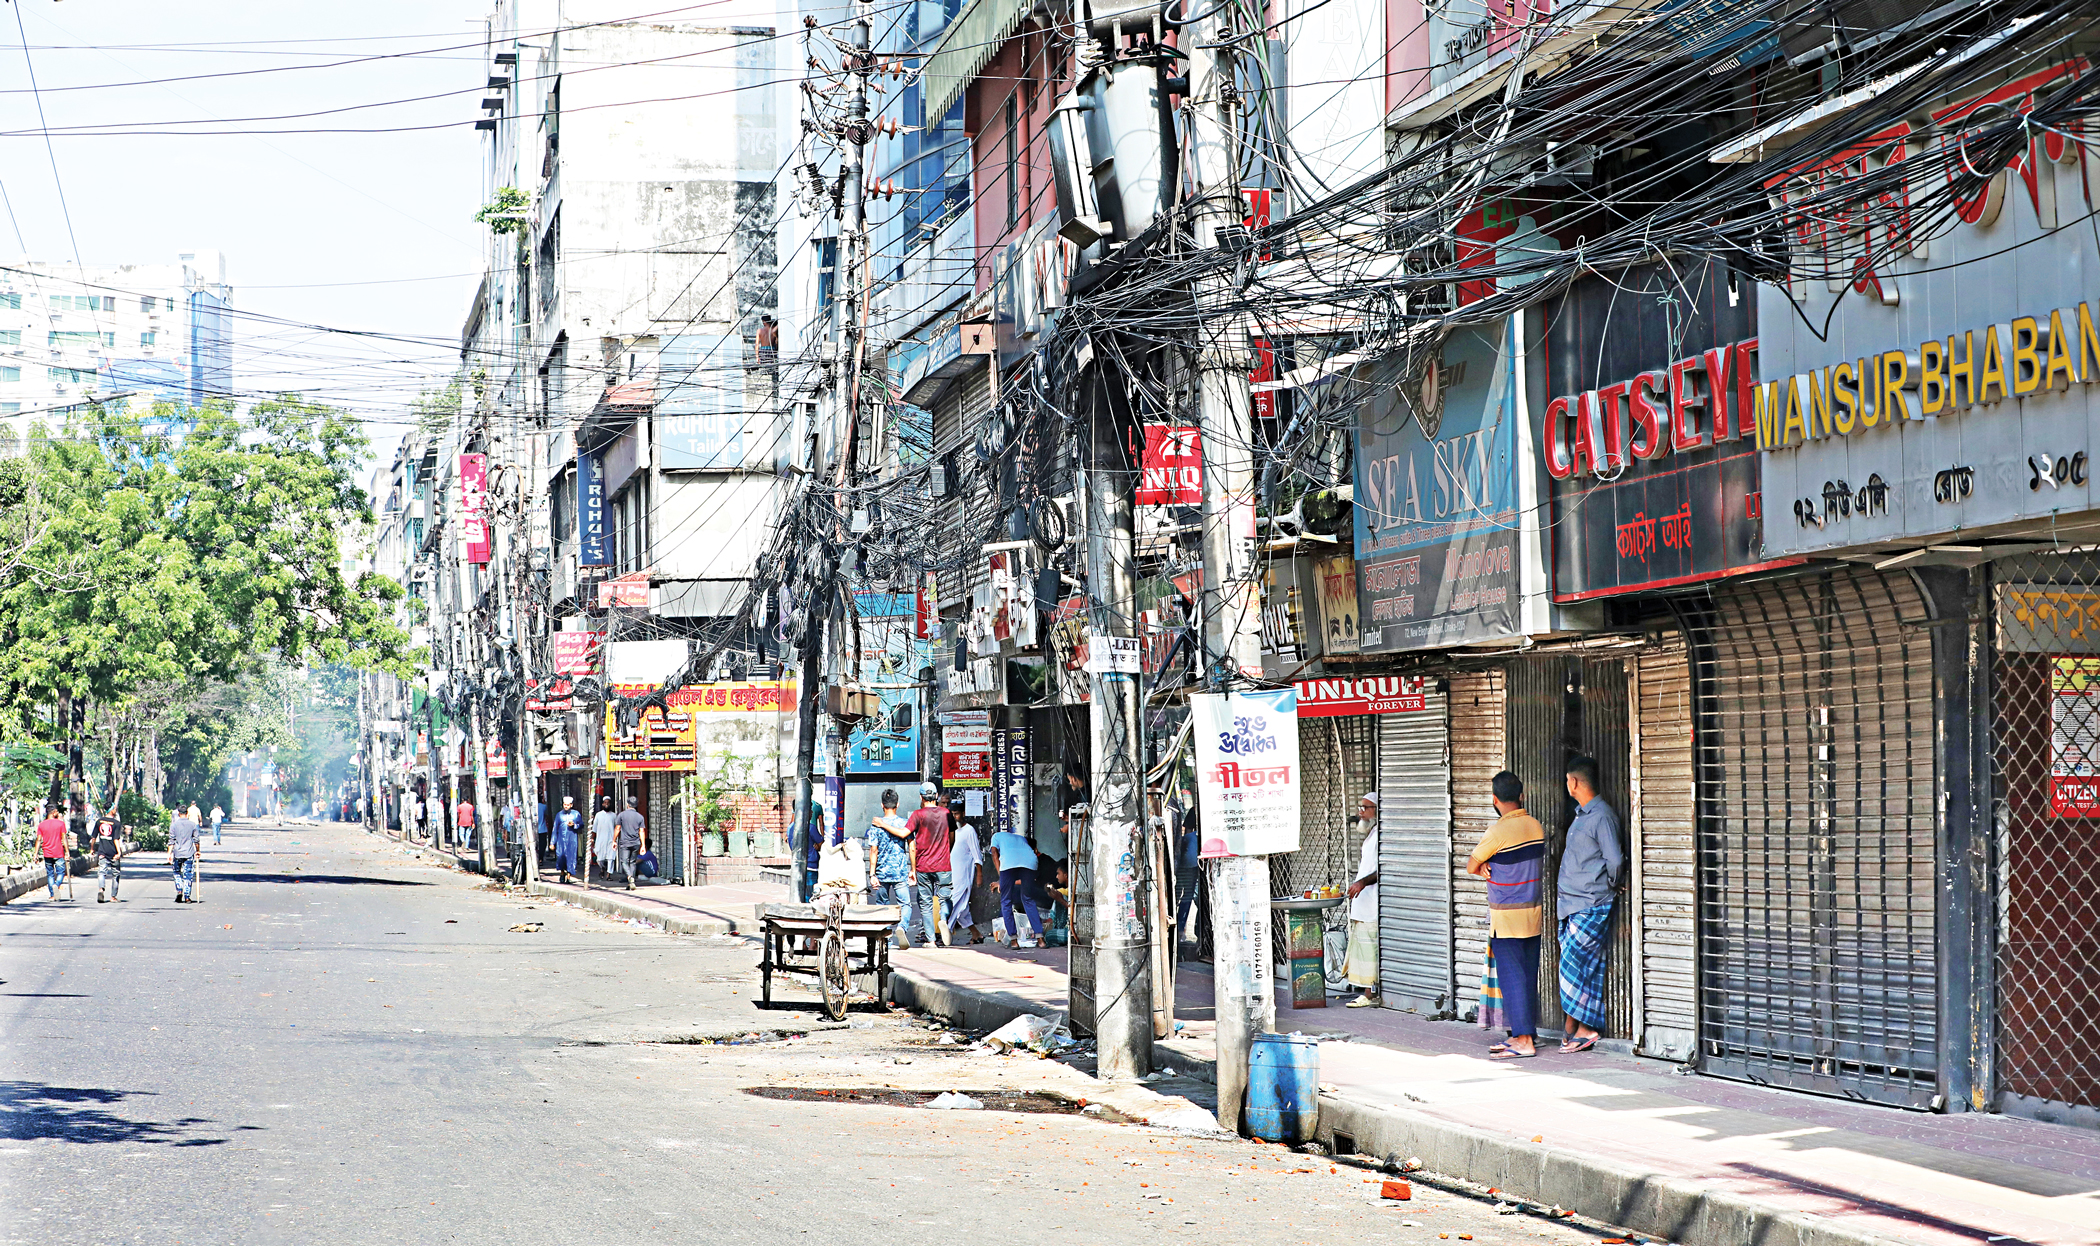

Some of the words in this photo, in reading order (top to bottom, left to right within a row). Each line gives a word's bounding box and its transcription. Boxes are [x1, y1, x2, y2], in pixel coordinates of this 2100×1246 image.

[1755, 348, 1911, 451] MANSUR
[1920, 301, 2100, 417] BHABAN
[1367, 449, 1424, 534] SEA
[1433, 424, 1498, 520] SKY
[1933, 463, 1975, 504] রোড
[2027, 450, 2088, 492] ১২০৫
[1417, 528, 1431, 543] Three
[1431, 525, 1445, 543] piece
[1659, 503, 1692, 549] আই
[1445, 542, 1511, 583] Monolova
[1450, 589, 1480, 611] Leather
[1480, 586, 1507, 607] House
[557, 634, 583, 645] Pick
[1360, 625, 1382, 648] Limited
[1294, 675, 1421, 702] UNIQUE
[1367, 699, 1422, 712] FOREVER
[1233, 715, 1267, 737] শুভ
[1218, 731, 1277, 757] উদ্বোধন
[1206, 761, 1291, 789] শীতল
[2056, 784, 2098, 800] CITIZEN
[1253, 921, 1263, 979] 01712160169
